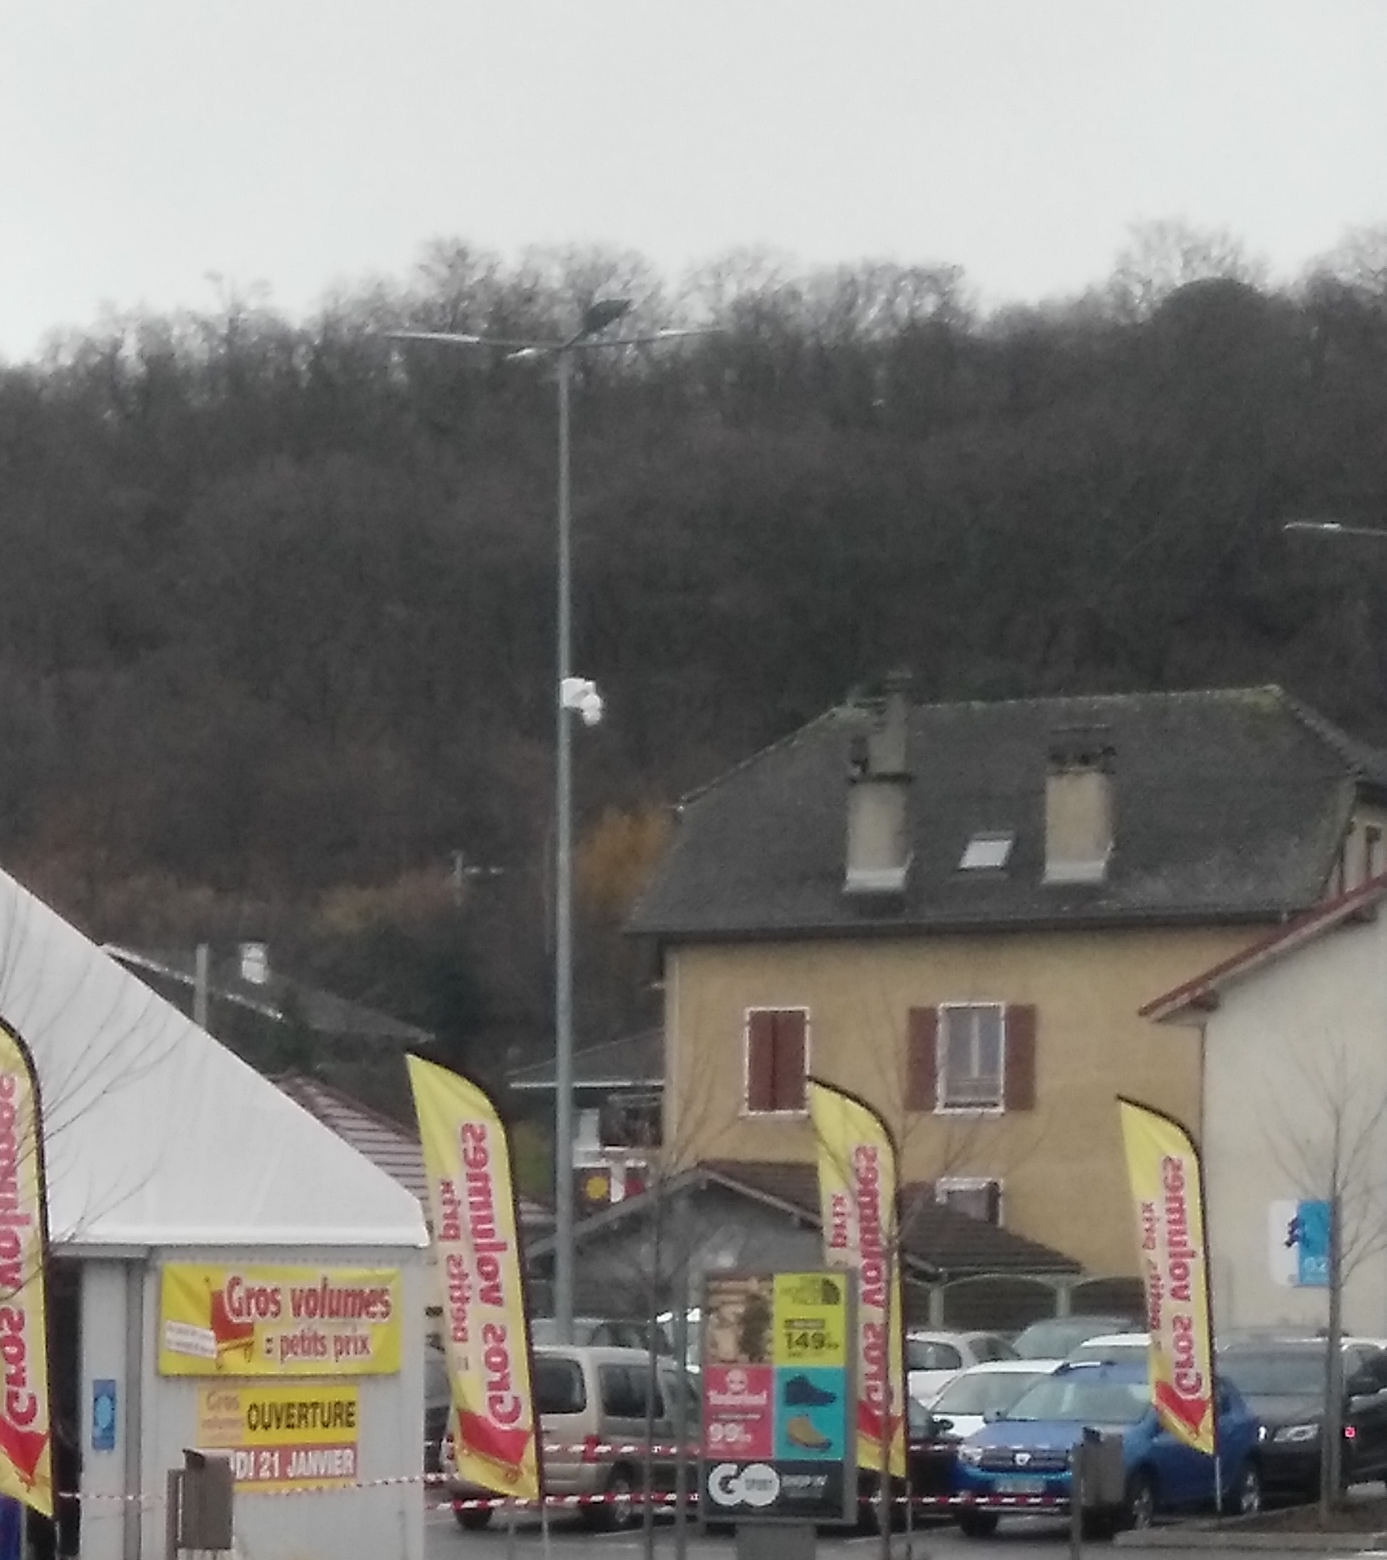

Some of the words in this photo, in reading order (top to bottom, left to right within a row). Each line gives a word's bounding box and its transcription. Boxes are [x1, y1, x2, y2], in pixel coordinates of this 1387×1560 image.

[225, 1275, 283, 1321] Gros
[289, 1274, 395, 1321] volumes
[280, 1330, 328, 1364] petits
[333, 1328, 371, 1364] prix
[246, 1399, 357, 1432] OUVERTURE
[259, 1450, 280, 1478] 21
[287, 1448, 355, 1477] JANVIER
